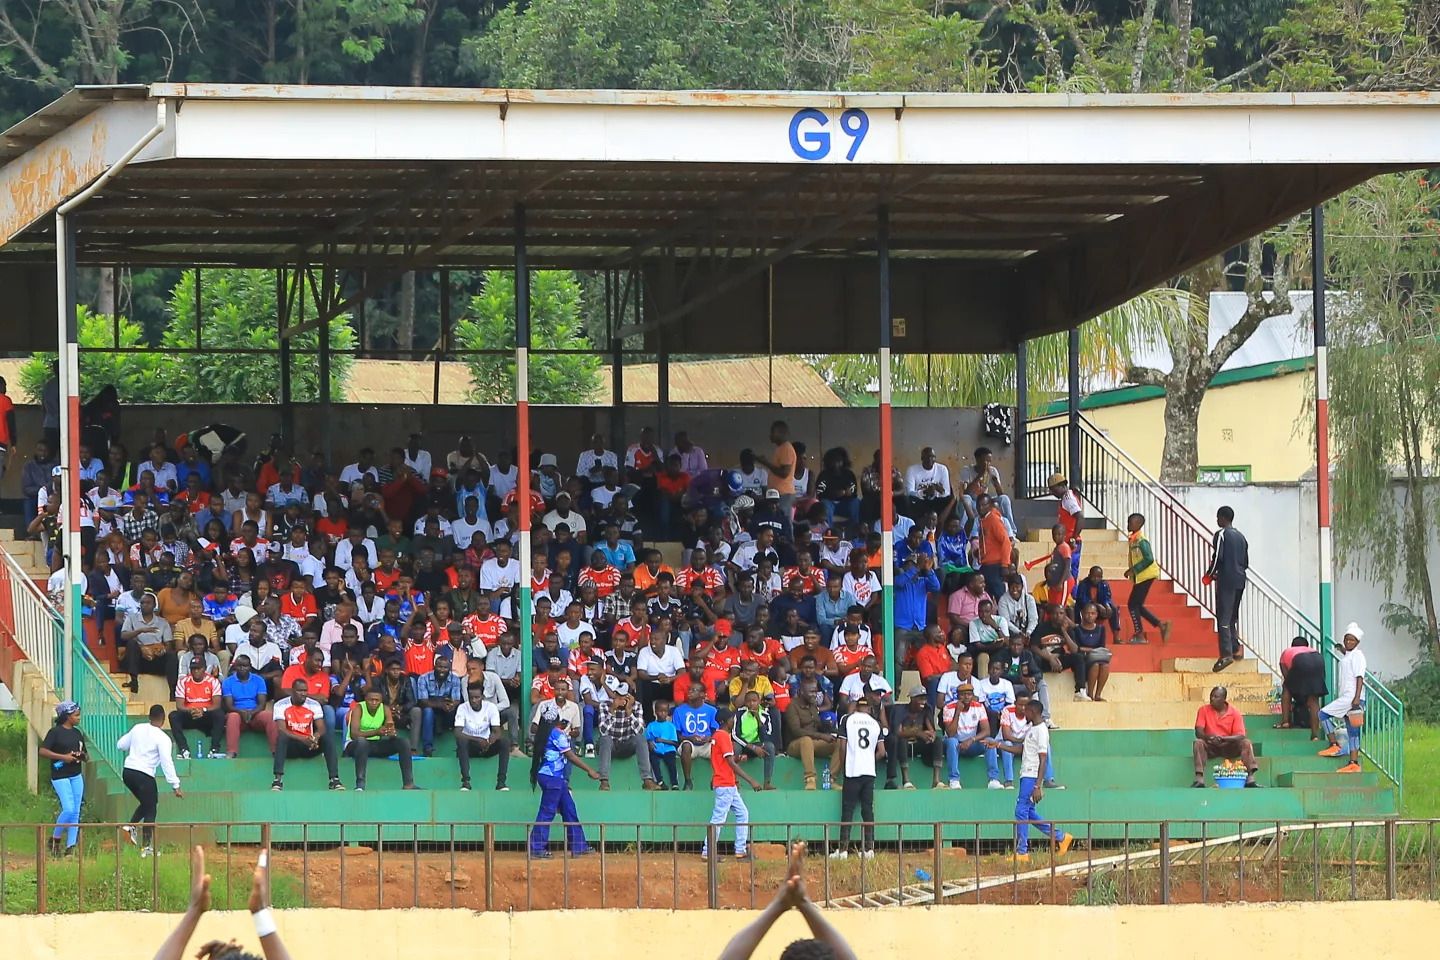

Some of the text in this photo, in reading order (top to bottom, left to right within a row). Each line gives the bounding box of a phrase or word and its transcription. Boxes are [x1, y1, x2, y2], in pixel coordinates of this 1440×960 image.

[789, 107, 870, 162] G9
[685, 712, 708, 733] 65
[858, 727, 870, 749] 8
